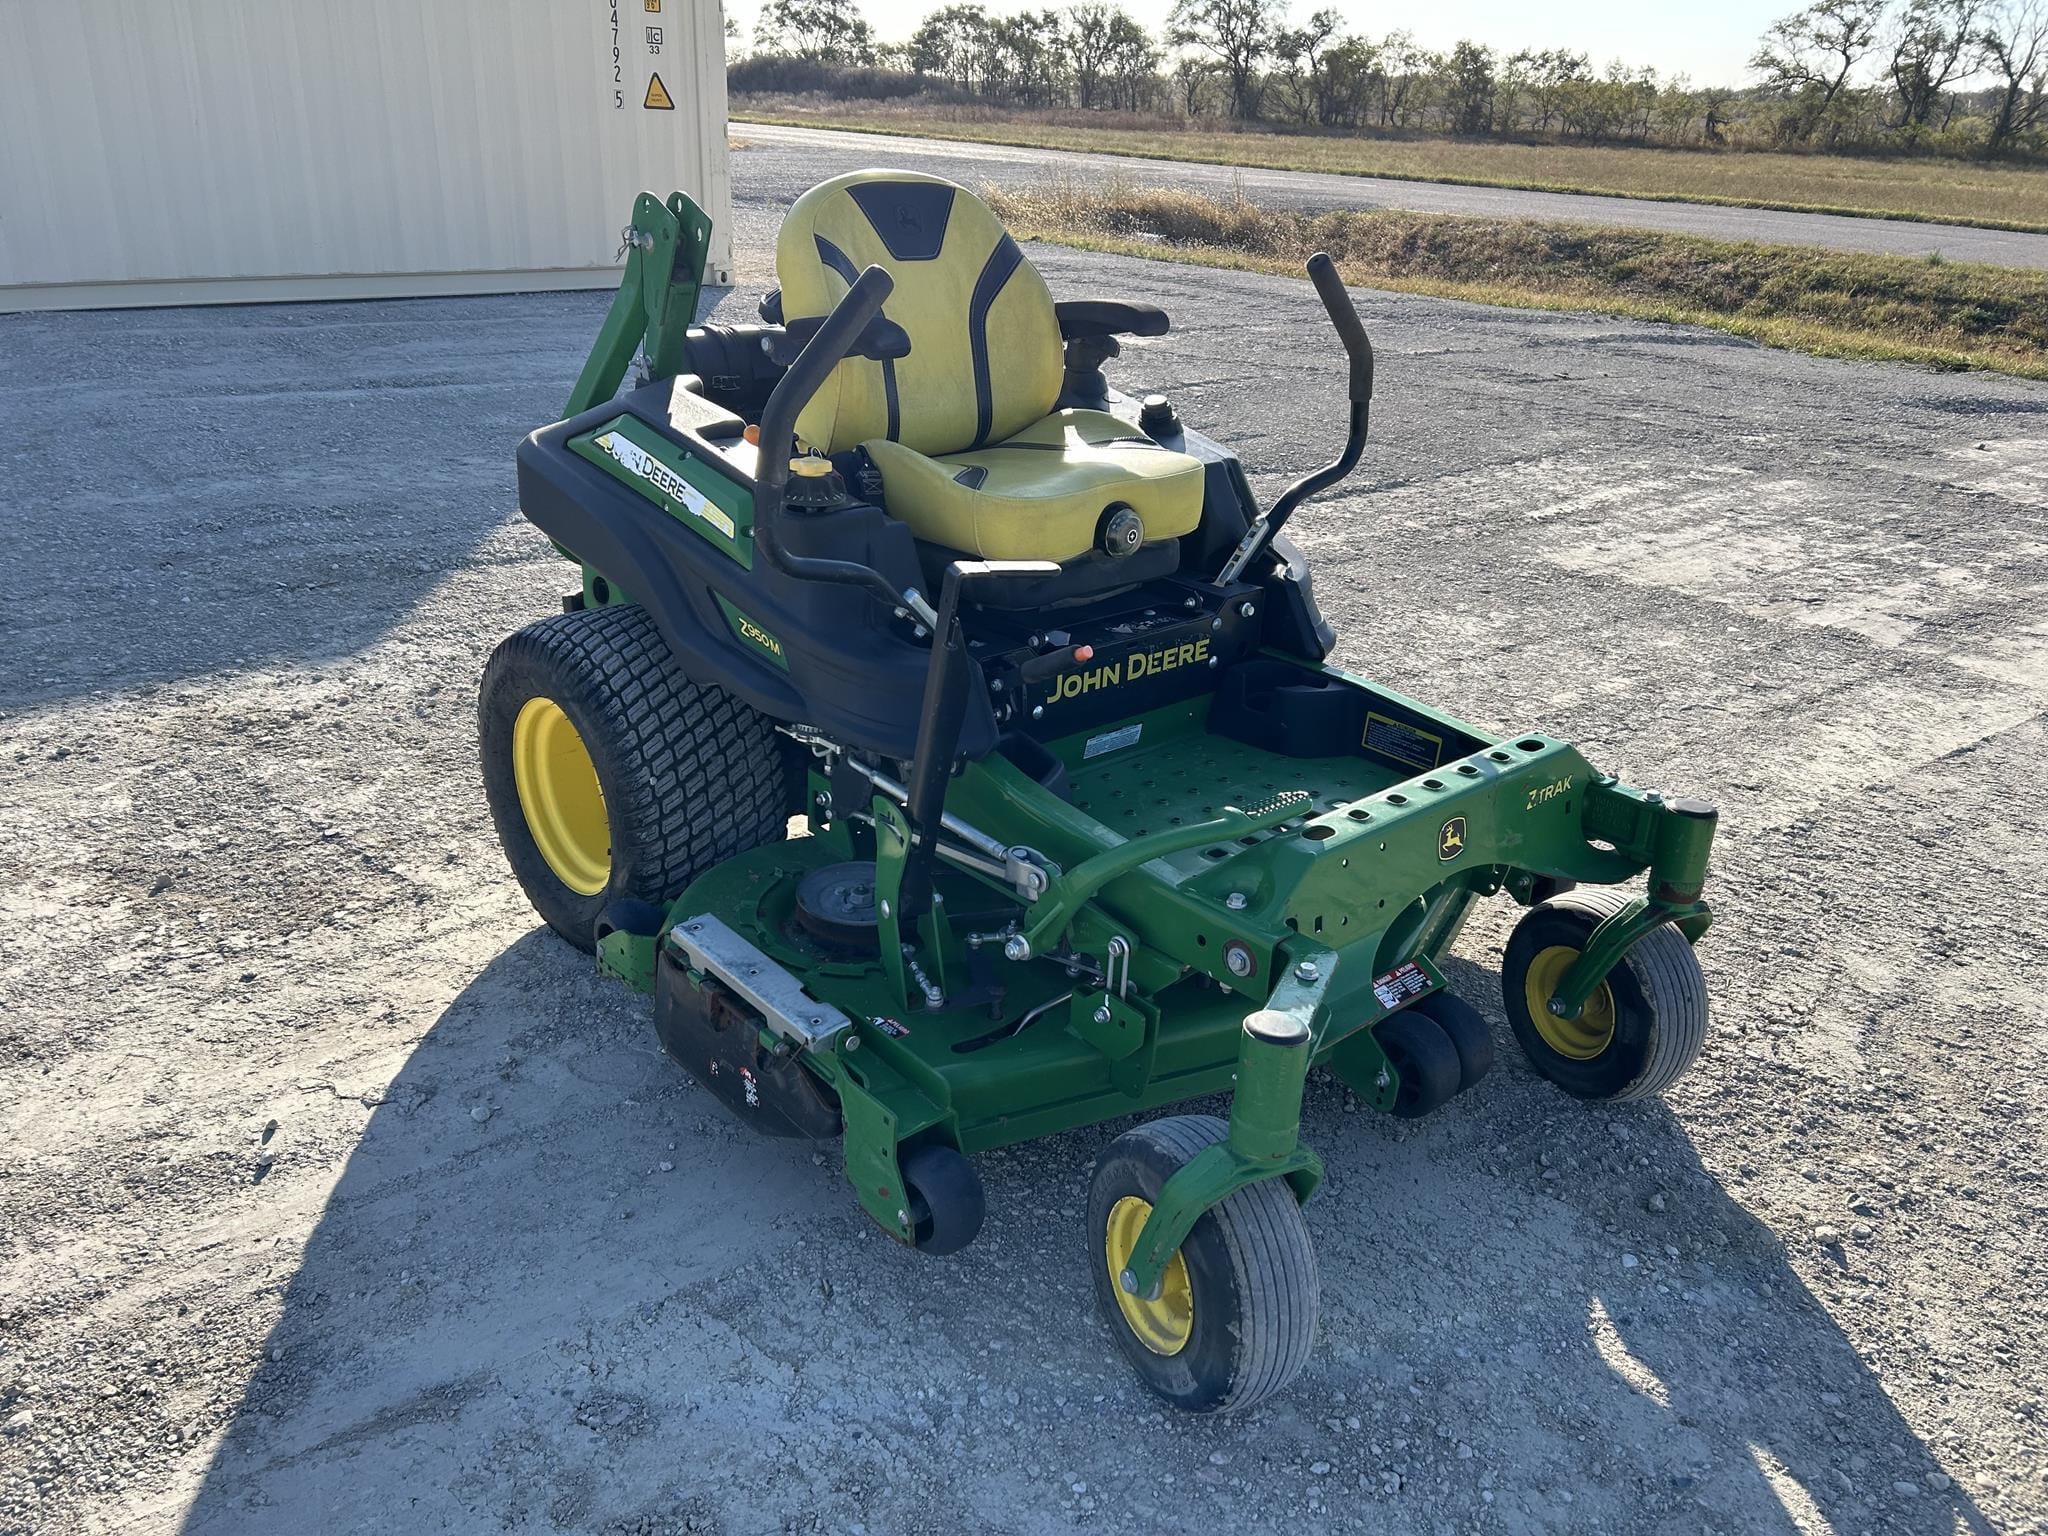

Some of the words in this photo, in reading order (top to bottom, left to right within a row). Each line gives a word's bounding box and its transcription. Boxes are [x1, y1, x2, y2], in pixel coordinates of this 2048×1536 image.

[649, 45, 660, 55] 33
[642, 456, 686, 501] DEERE
[738, 617, 781, 656] Z950M
[1046, 662, 1121, 704] JOHN
[1127, 638, 1210, 681] DEERE
